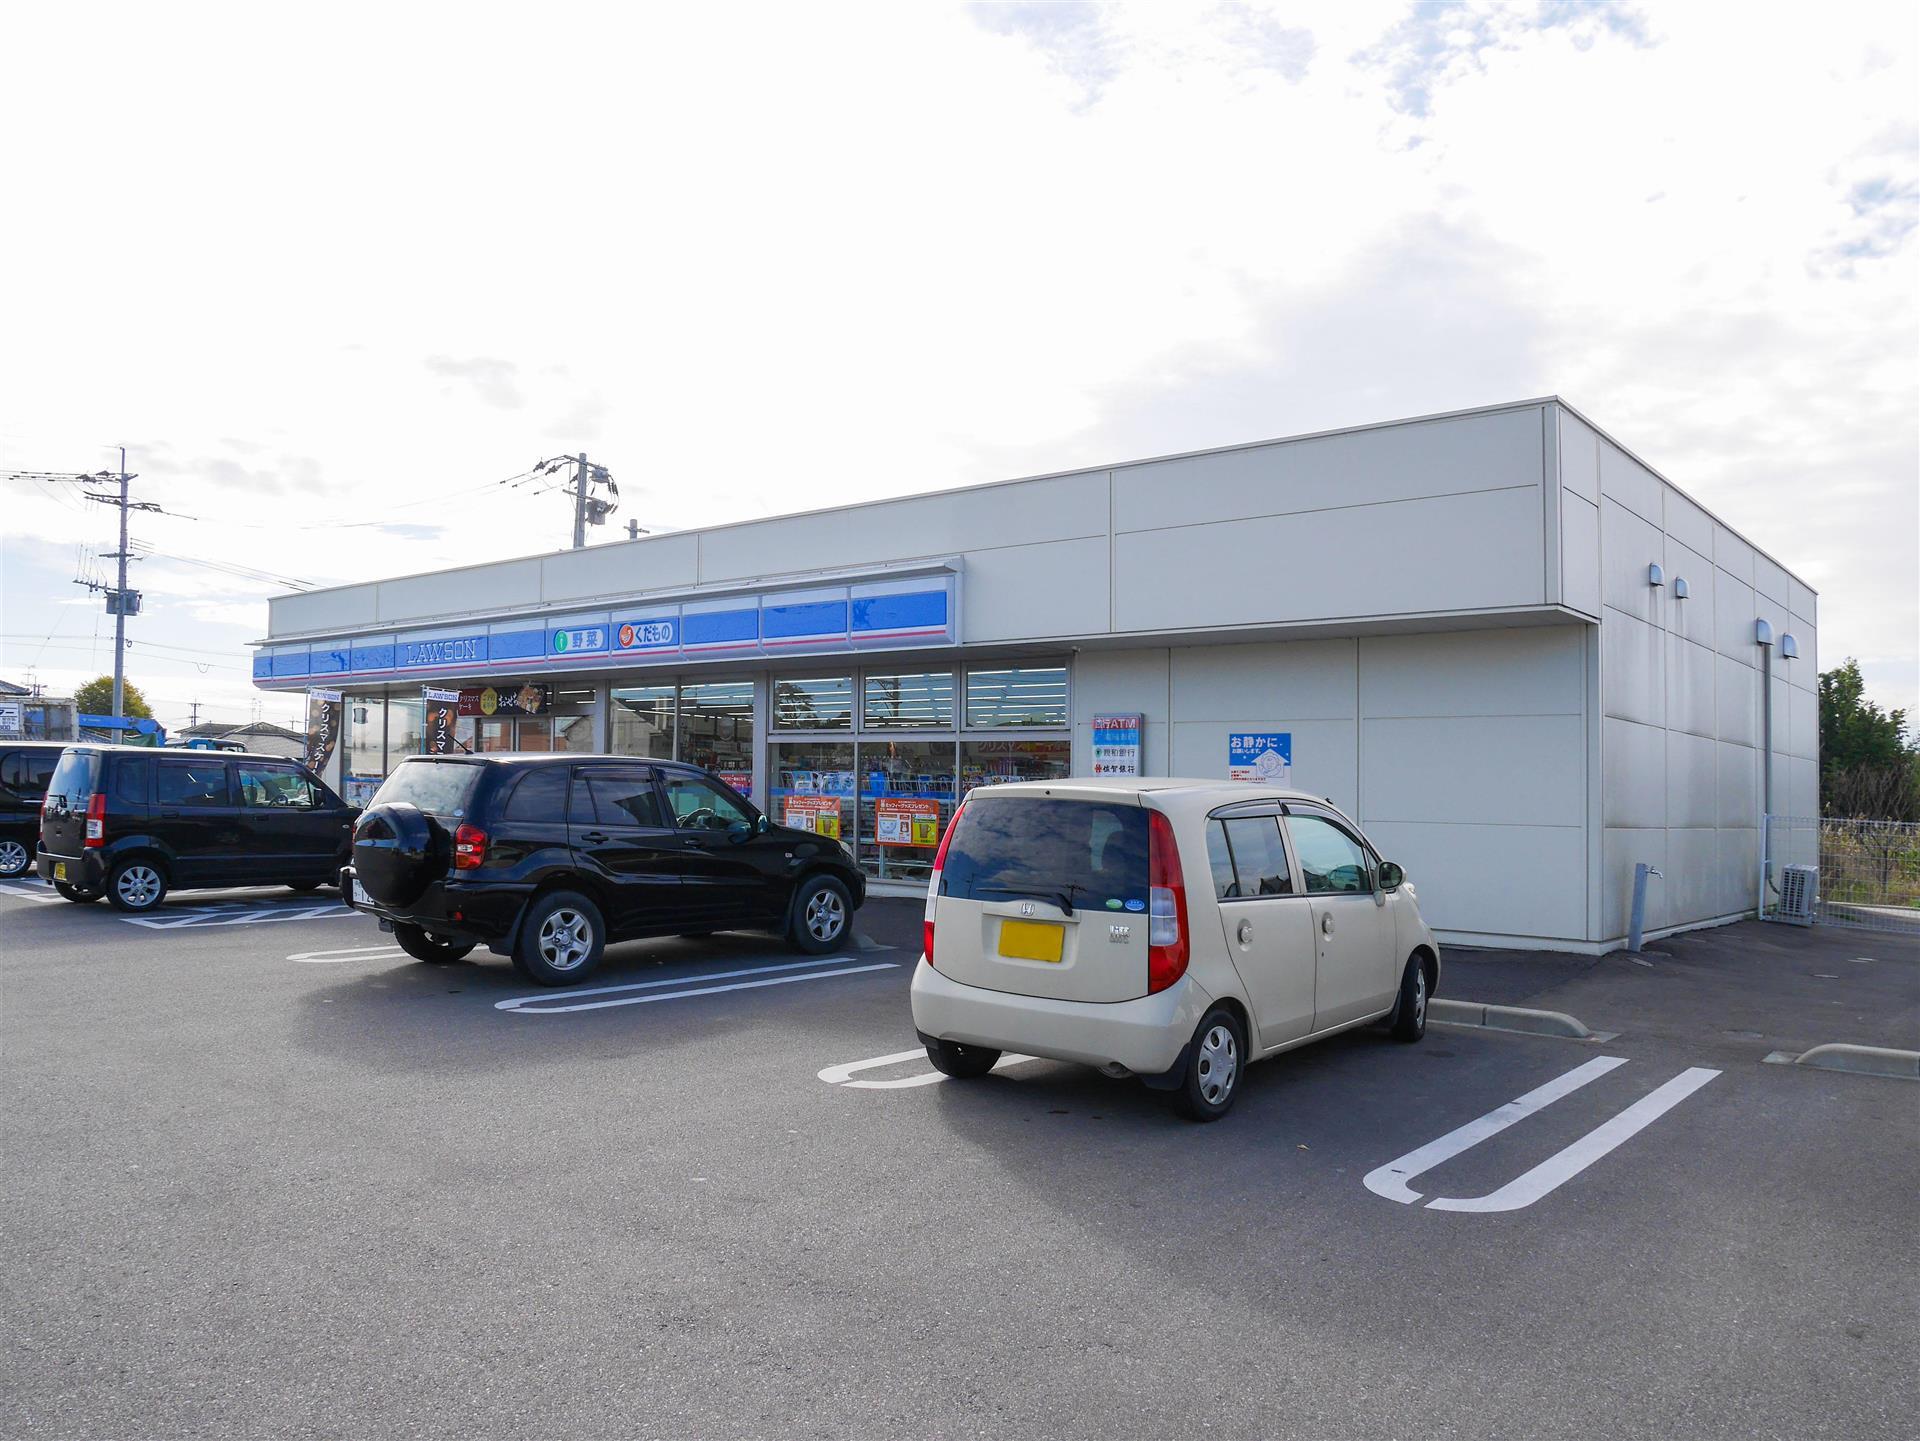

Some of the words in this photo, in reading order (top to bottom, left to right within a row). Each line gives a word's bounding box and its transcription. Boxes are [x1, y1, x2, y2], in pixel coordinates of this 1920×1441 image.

[572, 630, 598, 648] 野菜
[635, 624, 670, 642] くだもの
[407, 640, 476, 664] LAWSON
[436, 707, 448, 755] クリスマ
[1231, 736, 1278, 748] お静かに
[1103, 764, 1136, 773] 佐賀銀行
